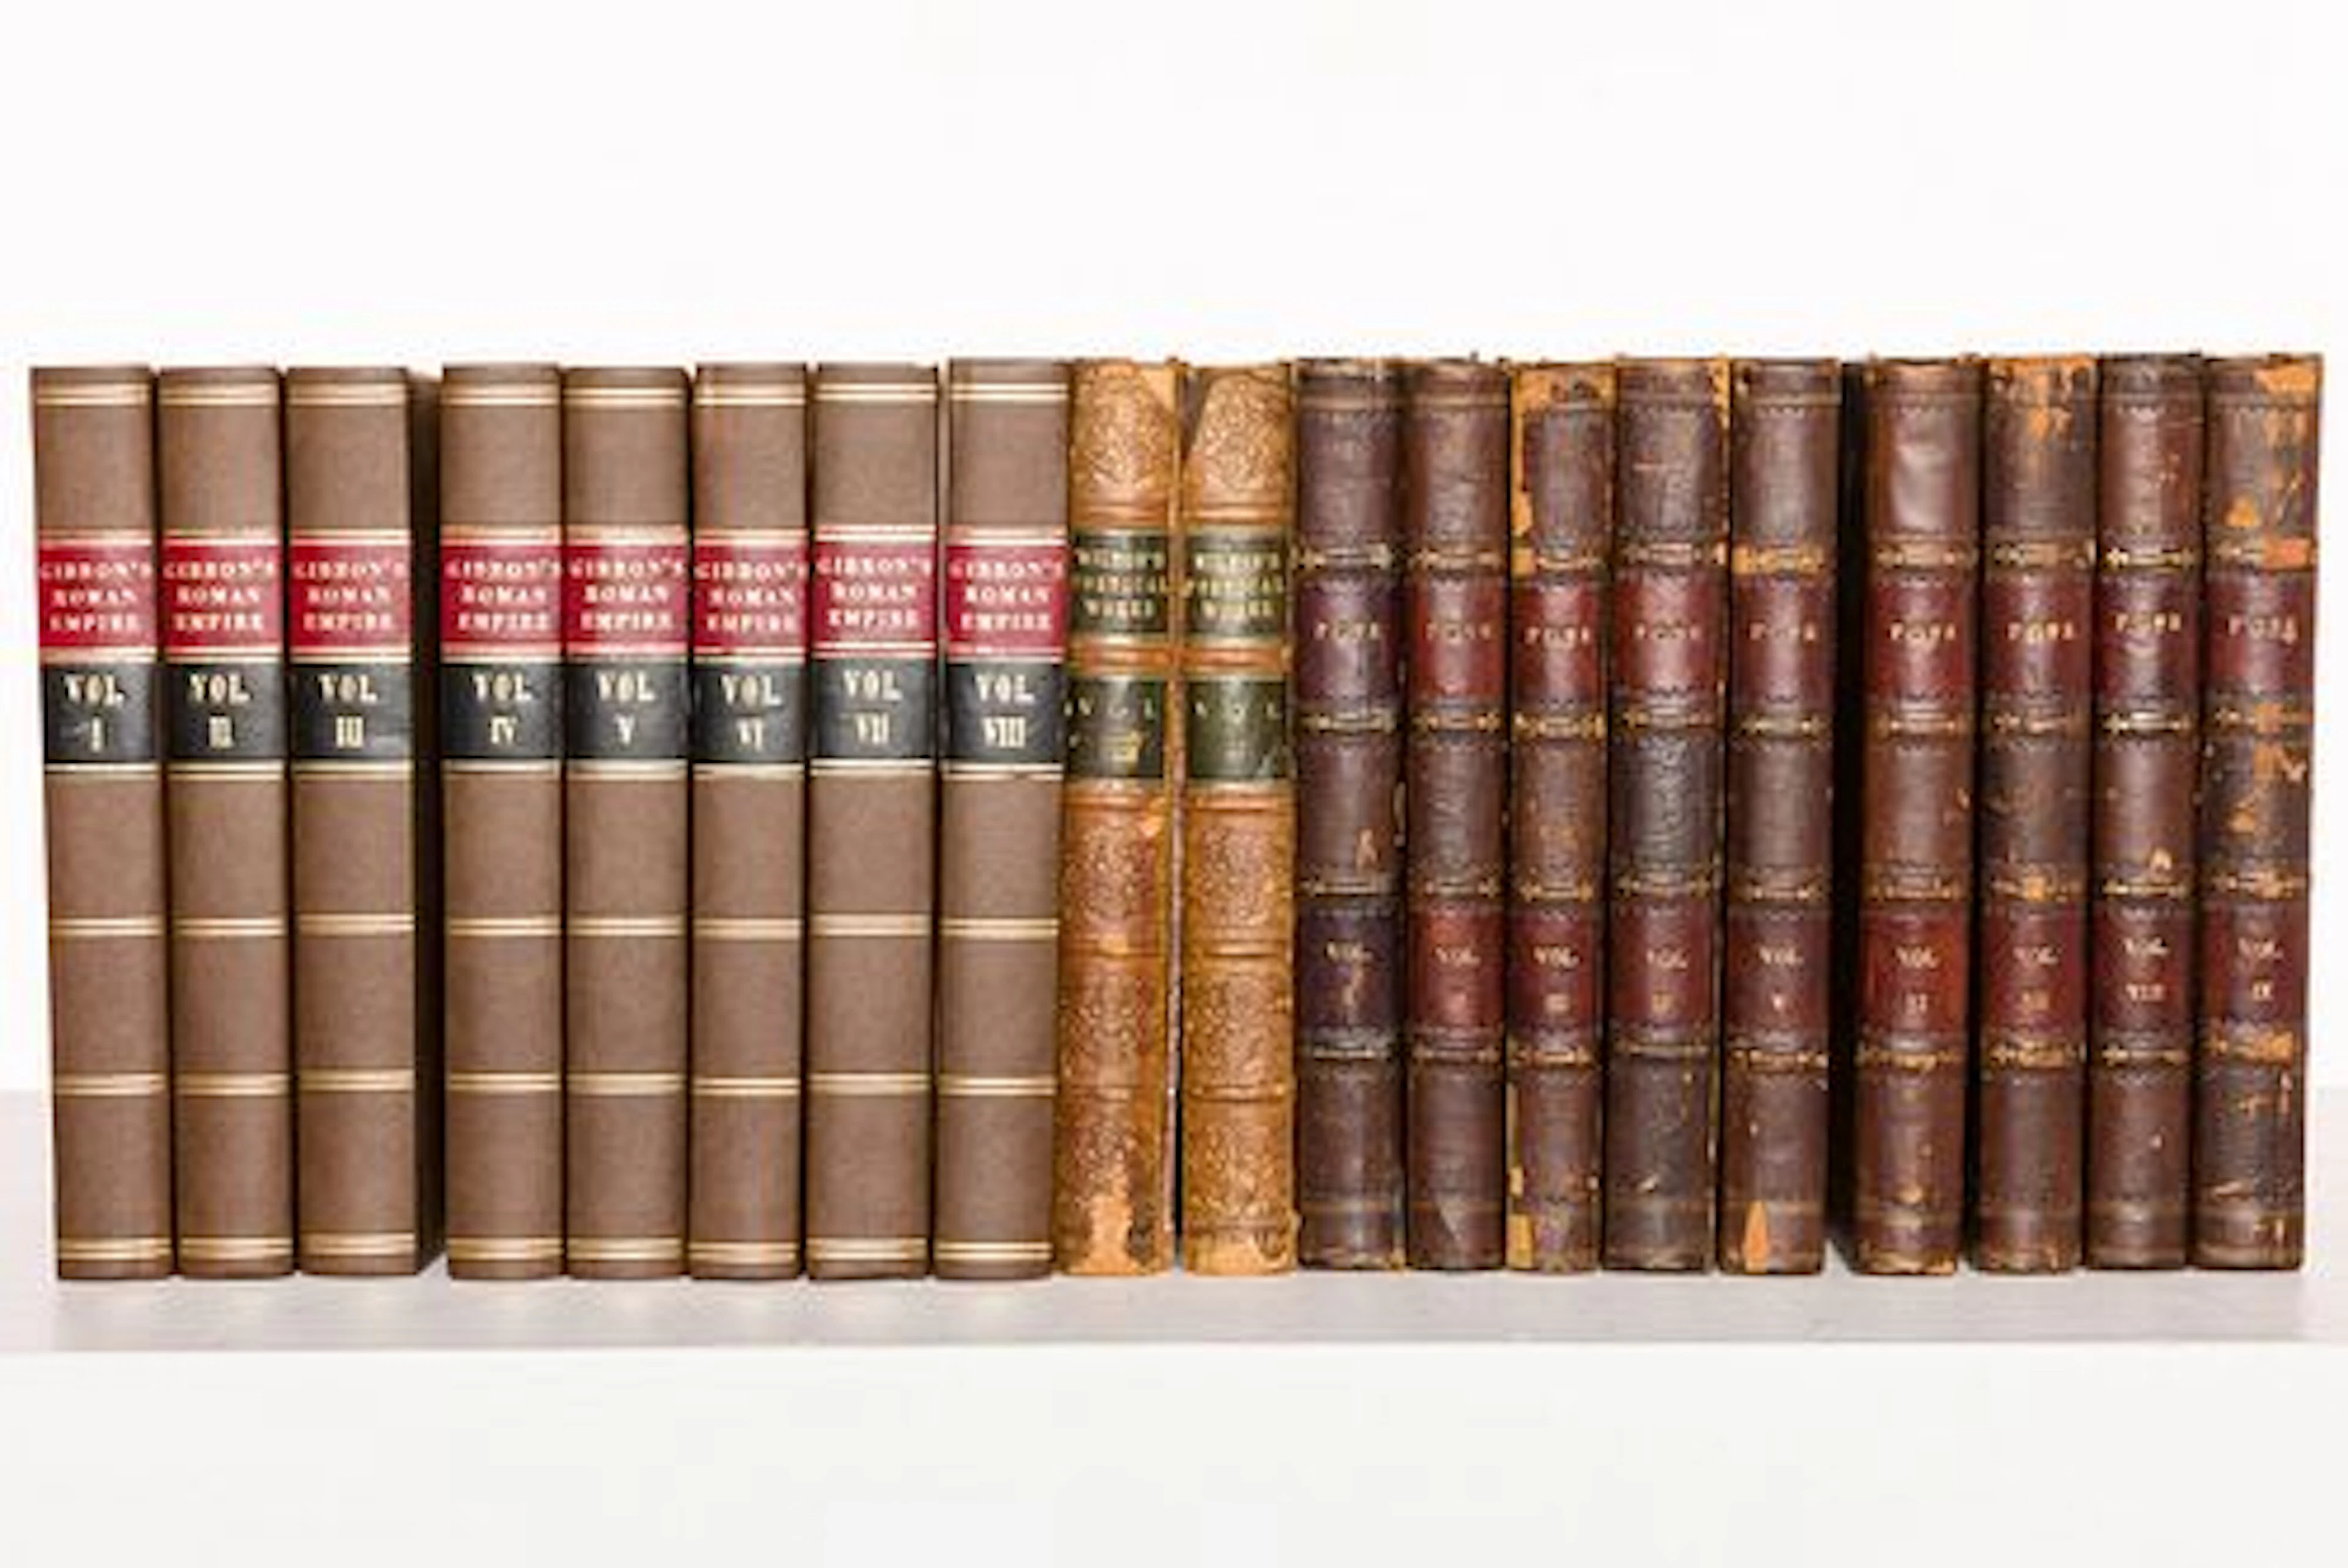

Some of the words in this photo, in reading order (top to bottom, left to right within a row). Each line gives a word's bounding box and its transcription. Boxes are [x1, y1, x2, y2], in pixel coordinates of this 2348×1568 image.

[54, 588, 138, 607] ROMAN
[177, 586, 261, 604] ROMAN
[308, 587, 391, 605] ROMAN
[460, 584, 547, 604] ROMAN
[585, 585, 670, 604] ROMAN
[709, 589, 794, 606] ROMAN
[830, 582, 917, 602] ROMAN
[965, 585, 1050, 603] ROMAN
